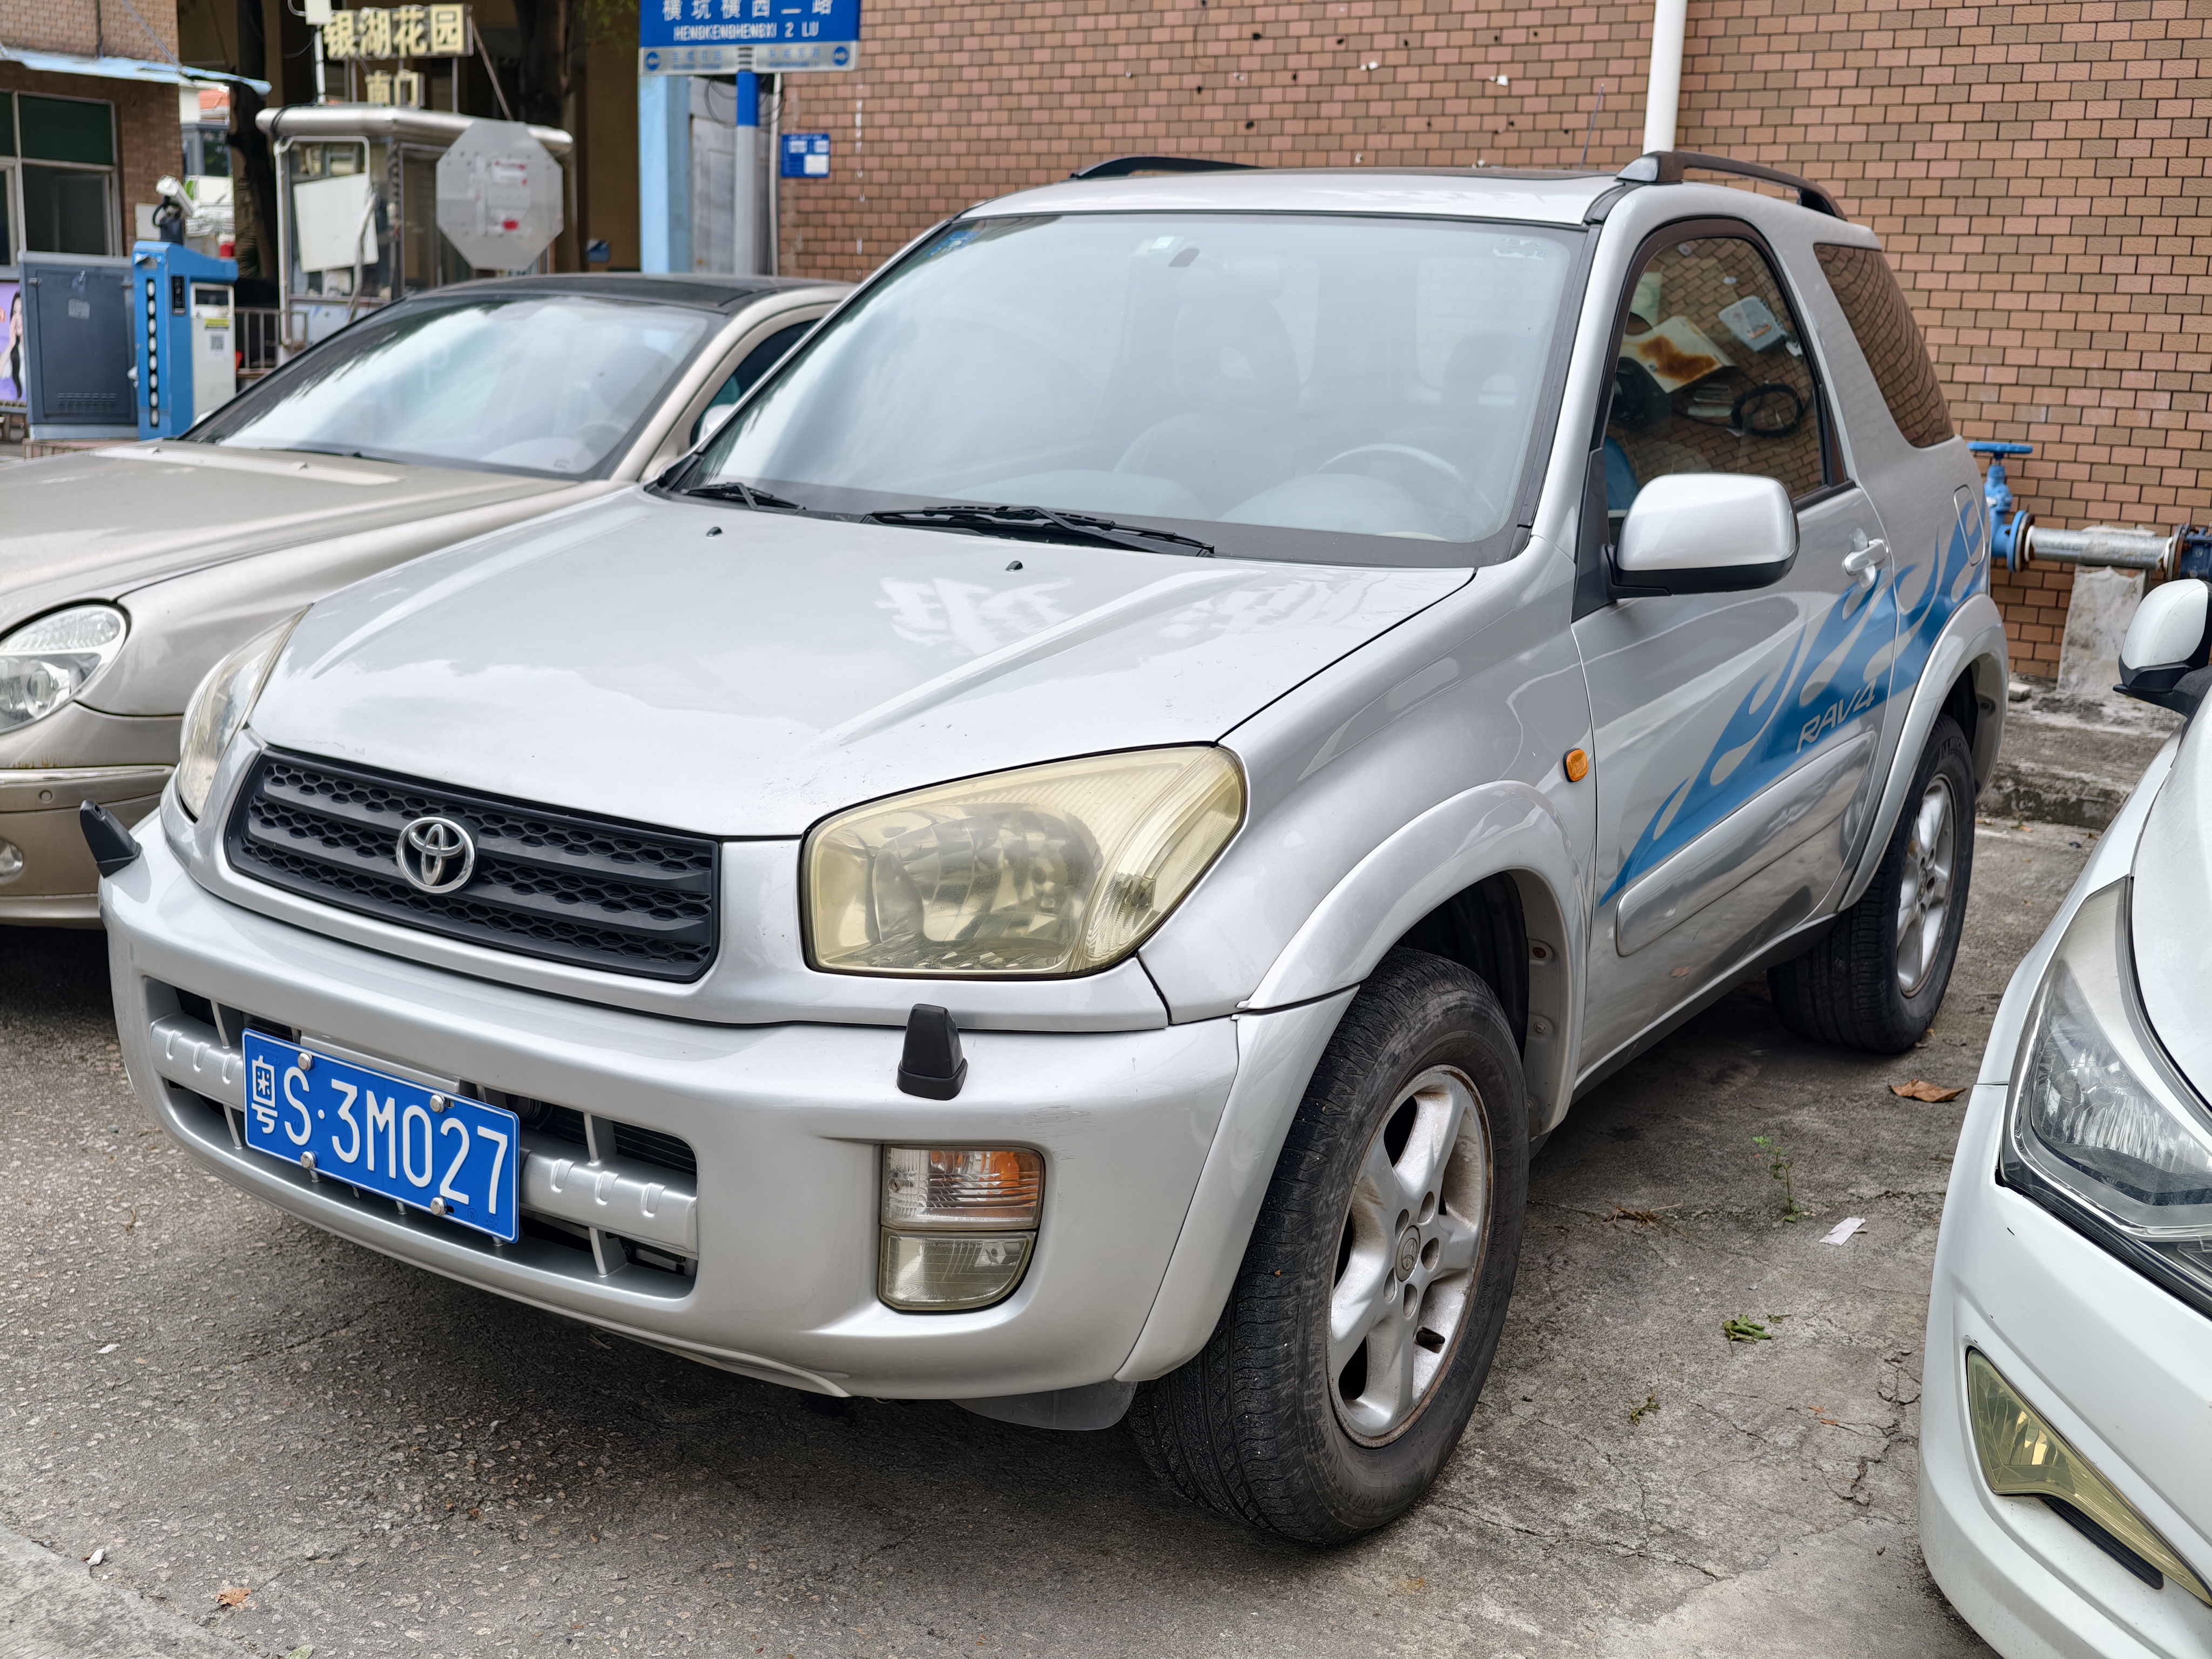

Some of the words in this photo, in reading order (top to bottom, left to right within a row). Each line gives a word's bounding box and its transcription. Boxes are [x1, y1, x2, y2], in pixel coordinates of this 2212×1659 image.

[323, 4, 464, 58] 银湖花园
[784, 21, 794, 38] 2
[801, 21, 819, 38] LU
[365, 70, 419, 107] 南门
[1796, 677, 1877, 754] RAV4
[251, 1055, 508, 1215] 粤S·3M027
